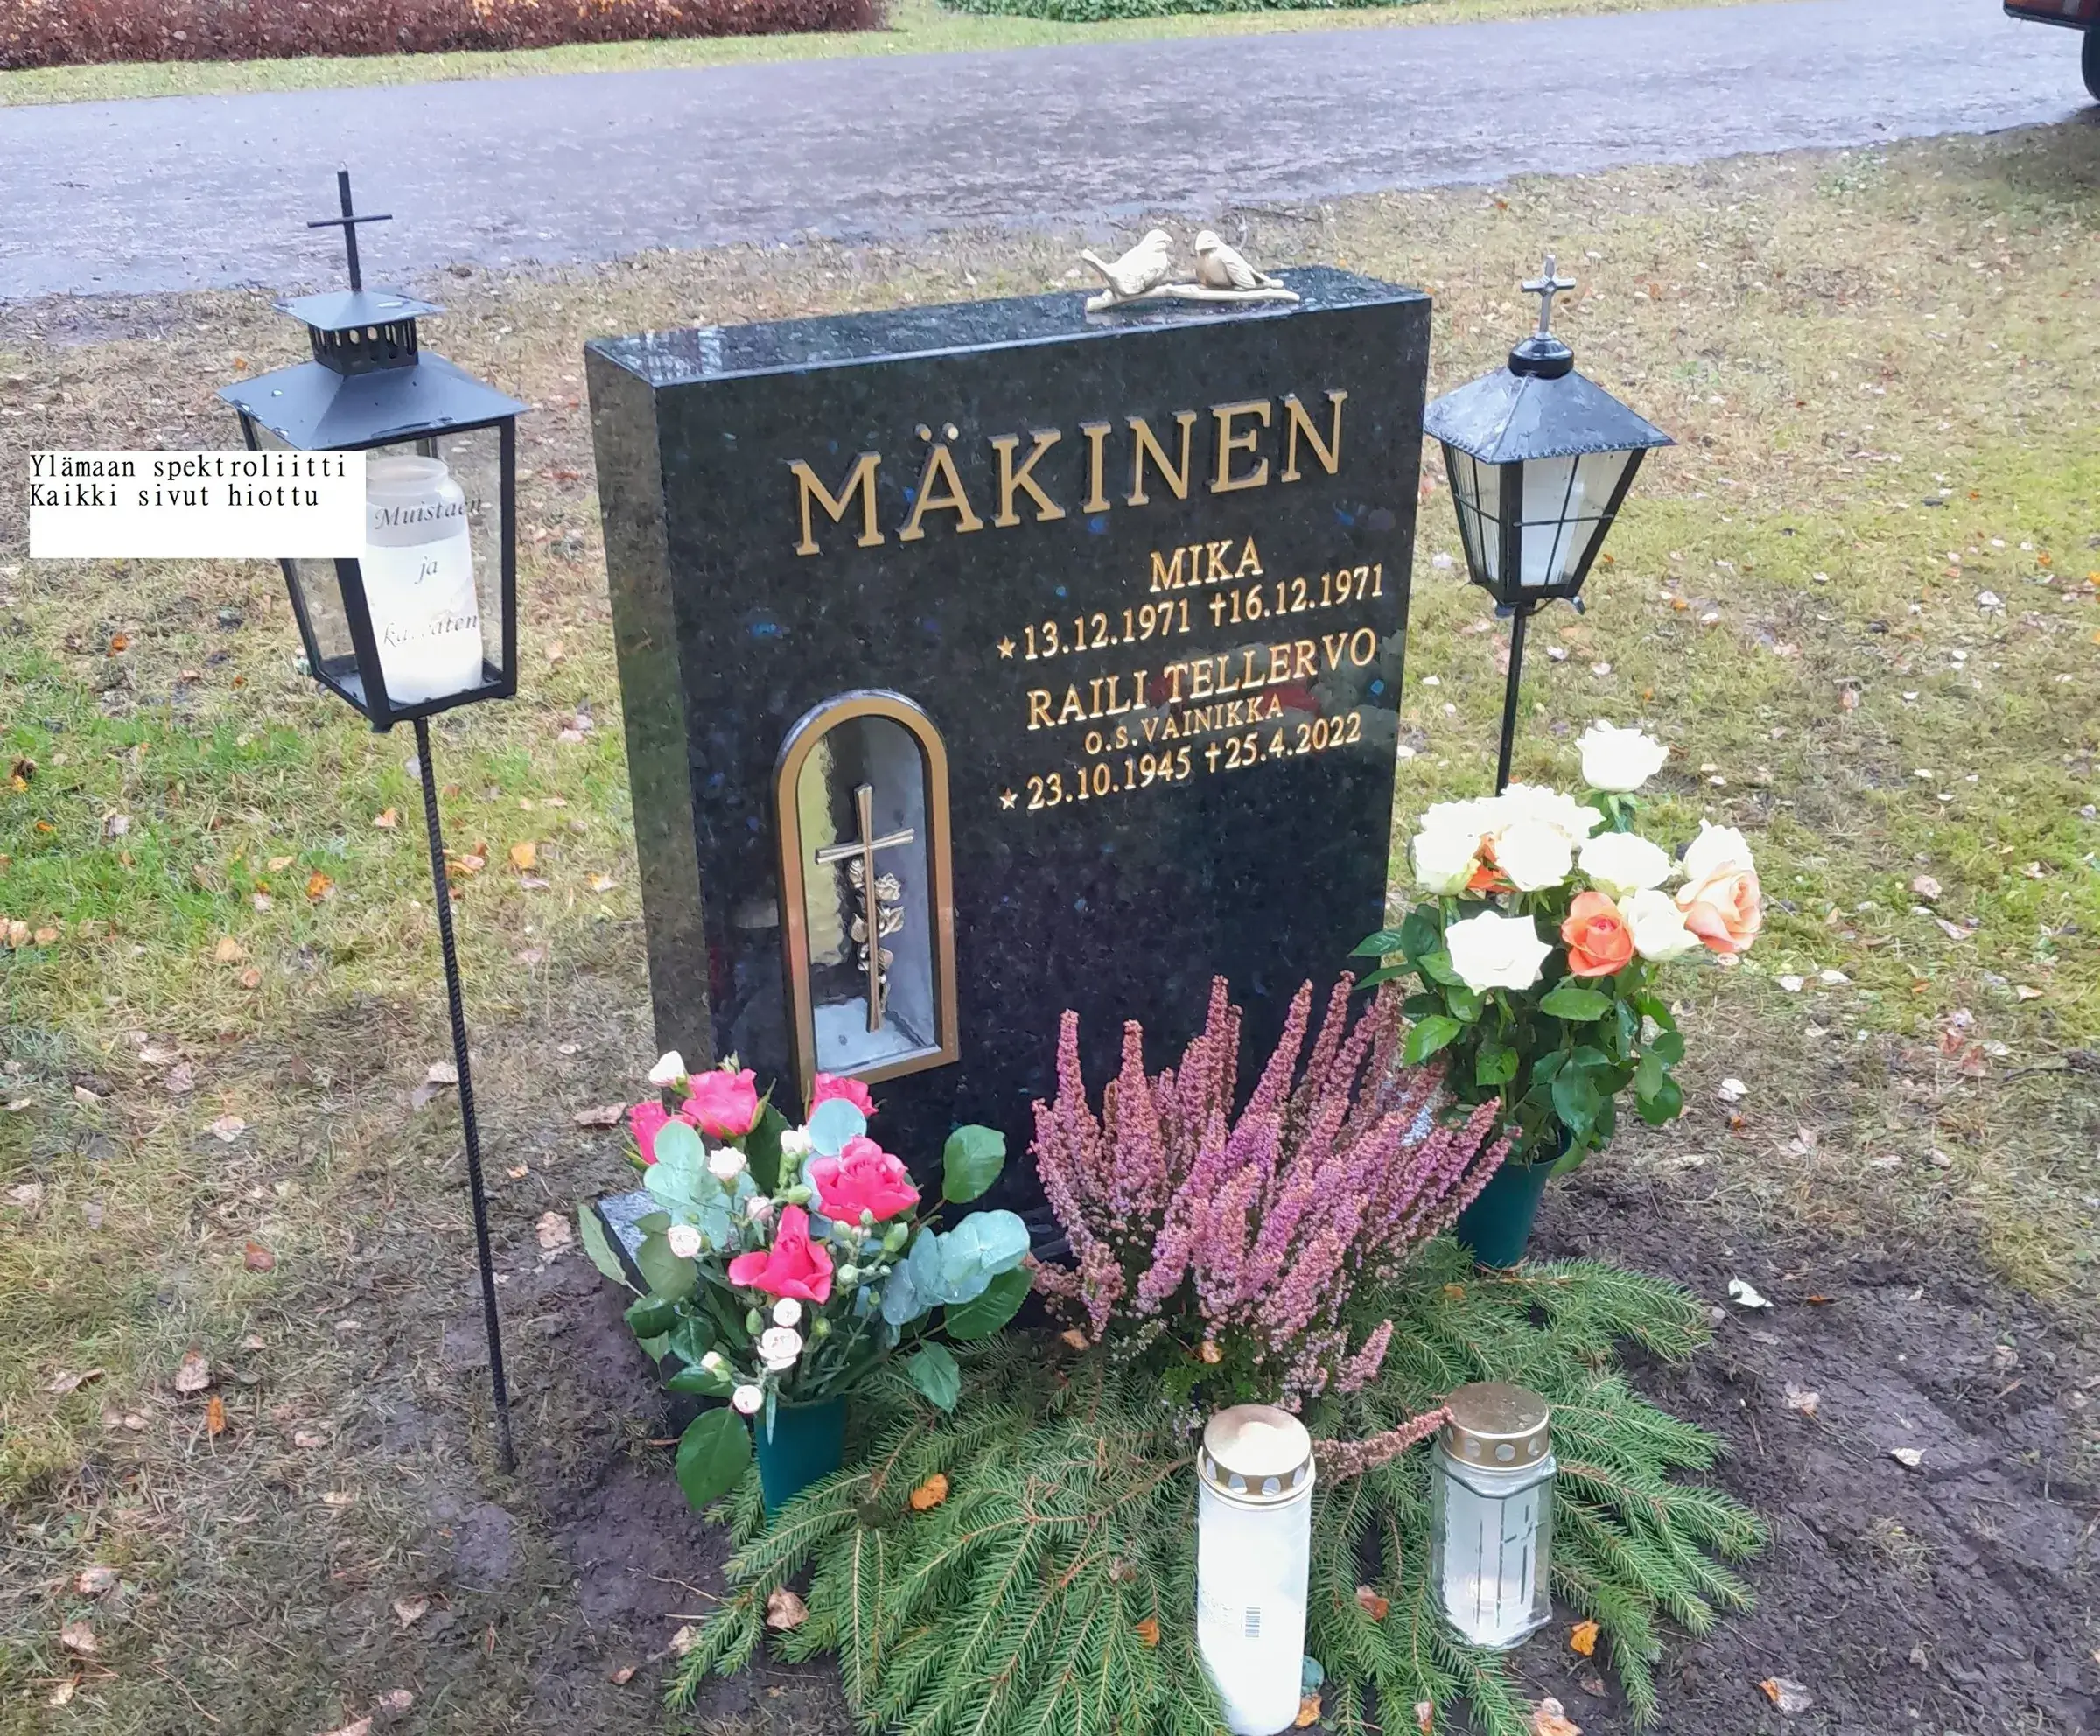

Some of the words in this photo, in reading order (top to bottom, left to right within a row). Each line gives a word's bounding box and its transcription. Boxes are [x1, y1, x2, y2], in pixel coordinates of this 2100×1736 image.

[787, 388, 1348, 556] MÄKINEN
[414, 556, 438, 584] ja
[1149, 536, 1264, 592] MIKA
[1026, 669, 1149, 731] RAILI
[1163, 627, 1378, 703] TELLERVO
